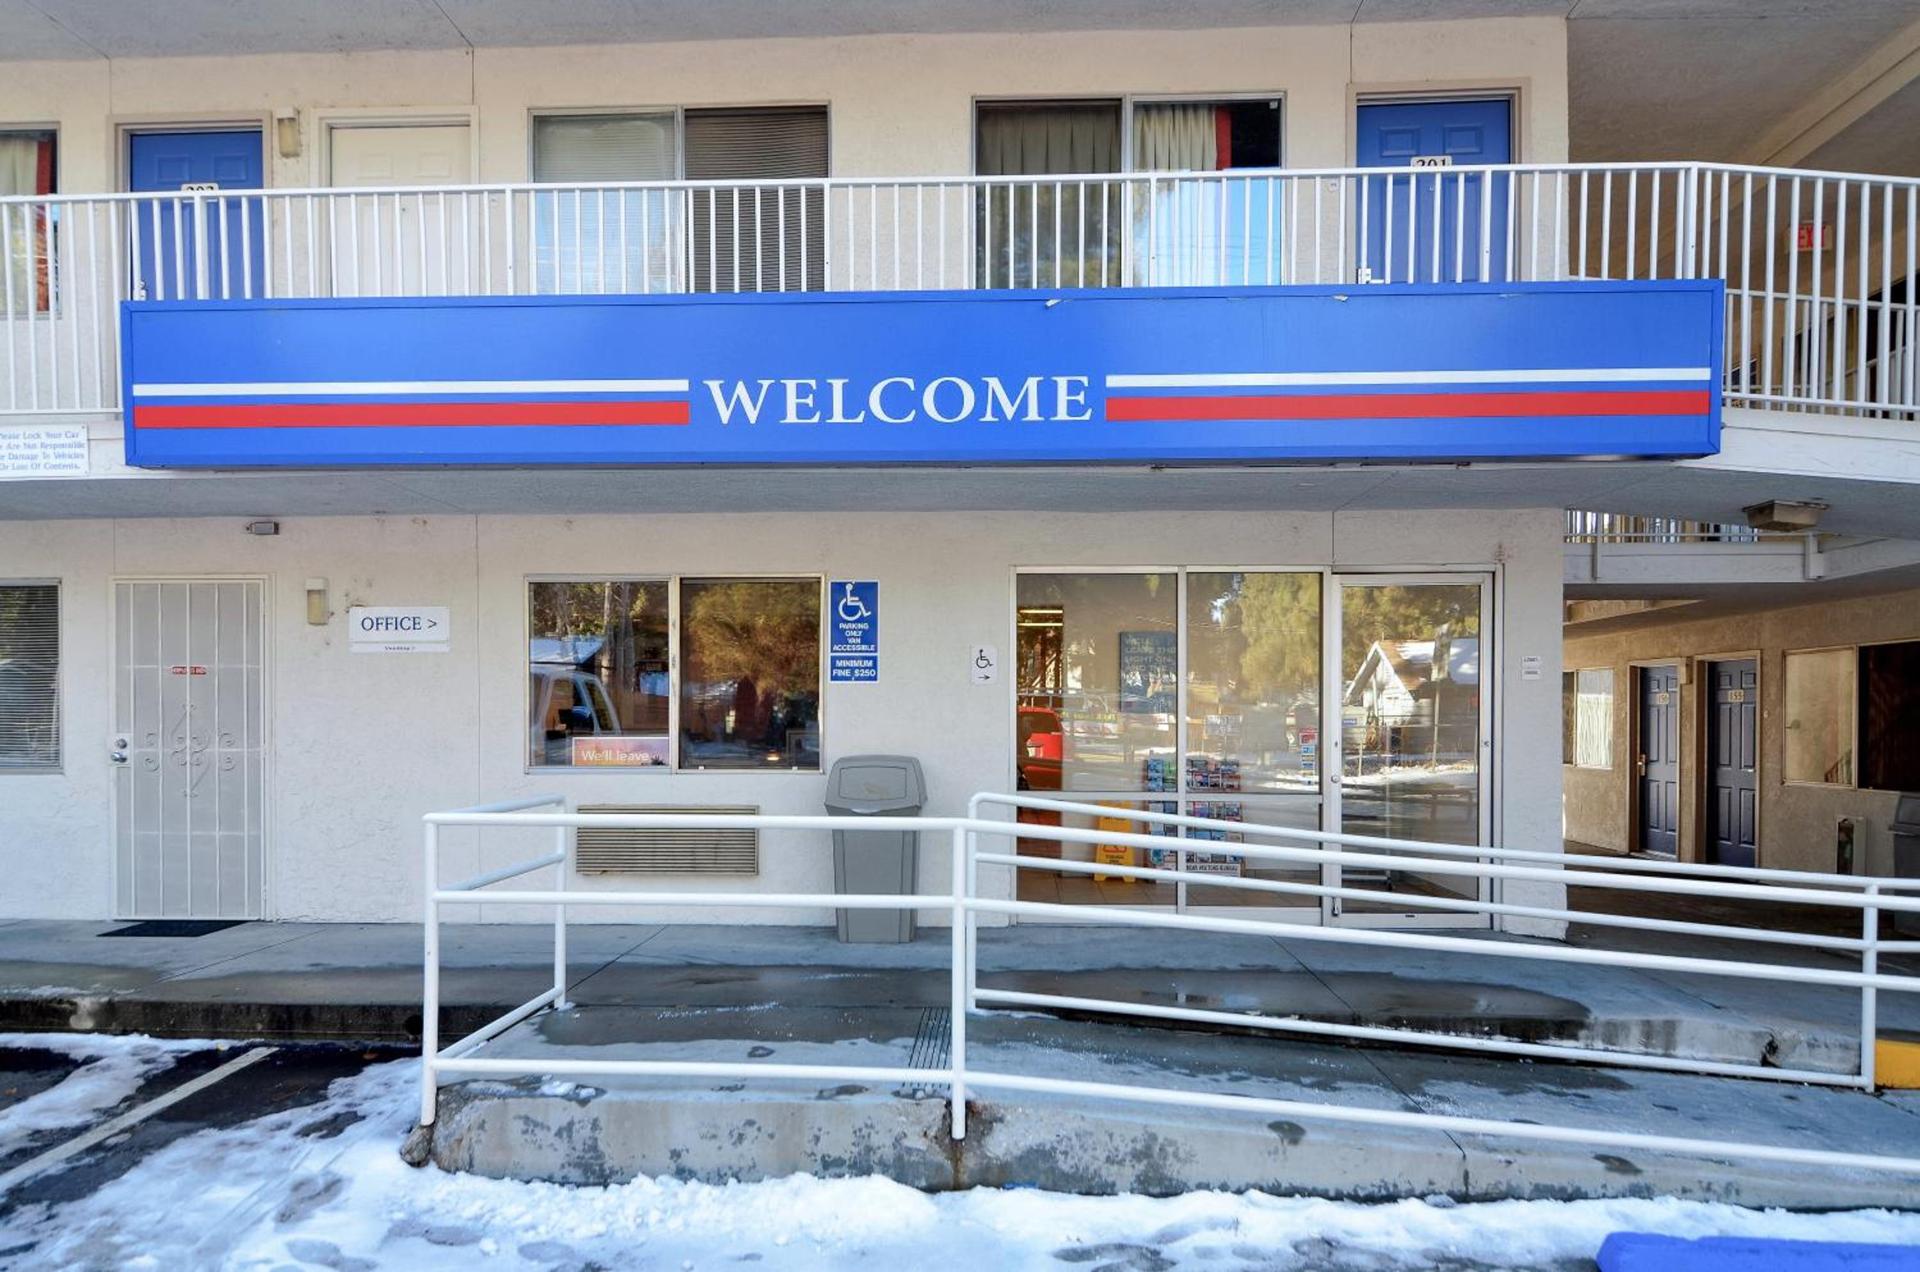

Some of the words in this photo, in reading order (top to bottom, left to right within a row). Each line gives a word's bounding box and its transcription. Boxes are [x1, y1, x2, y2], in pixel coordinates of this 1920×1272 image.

[703, 375, 1093, 425] WELCOME
[23, 431, 41, 439] Lock
[46, 431, 62, 439] Your
[65, 431, 79, 439] Car
[8, 452, 39, 461] Damage
[53, 451, 85, 460] Vehicles
[361, 616, 422, 631] OFFICE
[839, 622, 869, 630] PARKING
[836, 659, 873, 667] MINIMUM
[832, 668, 851, 677] FINE
[854, 668, 876, 677] $250
[581, 749, 612, 761] We'll
[616, 749, 650, 761] leave
